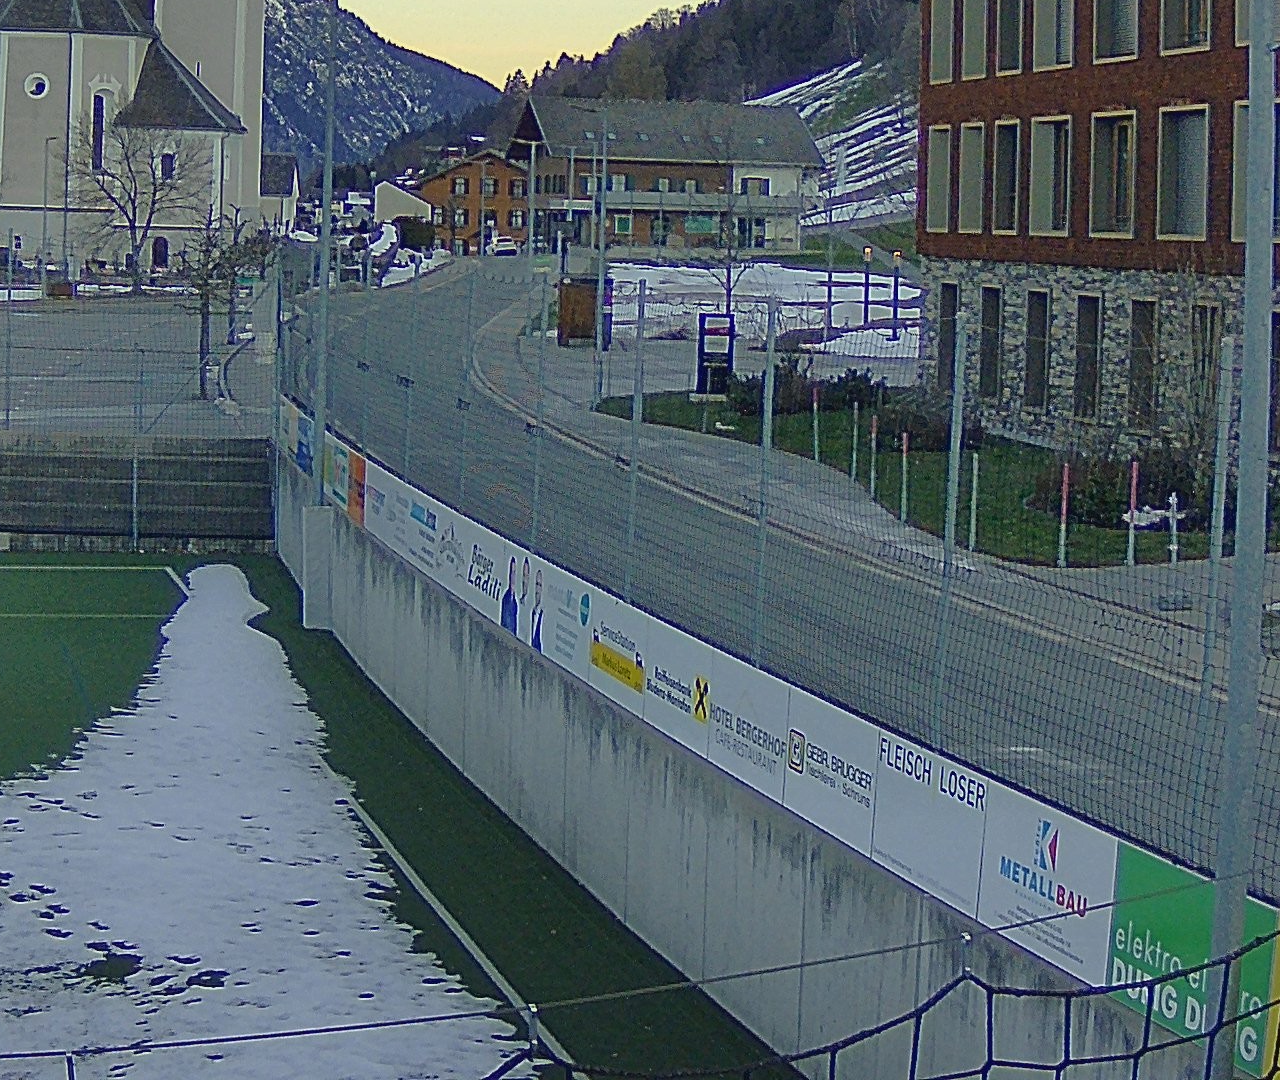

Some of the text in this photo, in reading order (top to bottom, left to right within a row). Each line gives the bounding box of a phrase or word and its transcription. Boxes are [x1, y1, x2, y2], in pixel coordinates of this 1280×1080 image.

[710, 703, 787, 759] HOTEL BERGERHOF
[831, 755, 873, 792] BRUGGER
[879, 737, 985, 812] FLEISCH LOSER
[1000, 855, 1088, 918] METALLBAU
[1115, 920, 1183, 976] elektro
